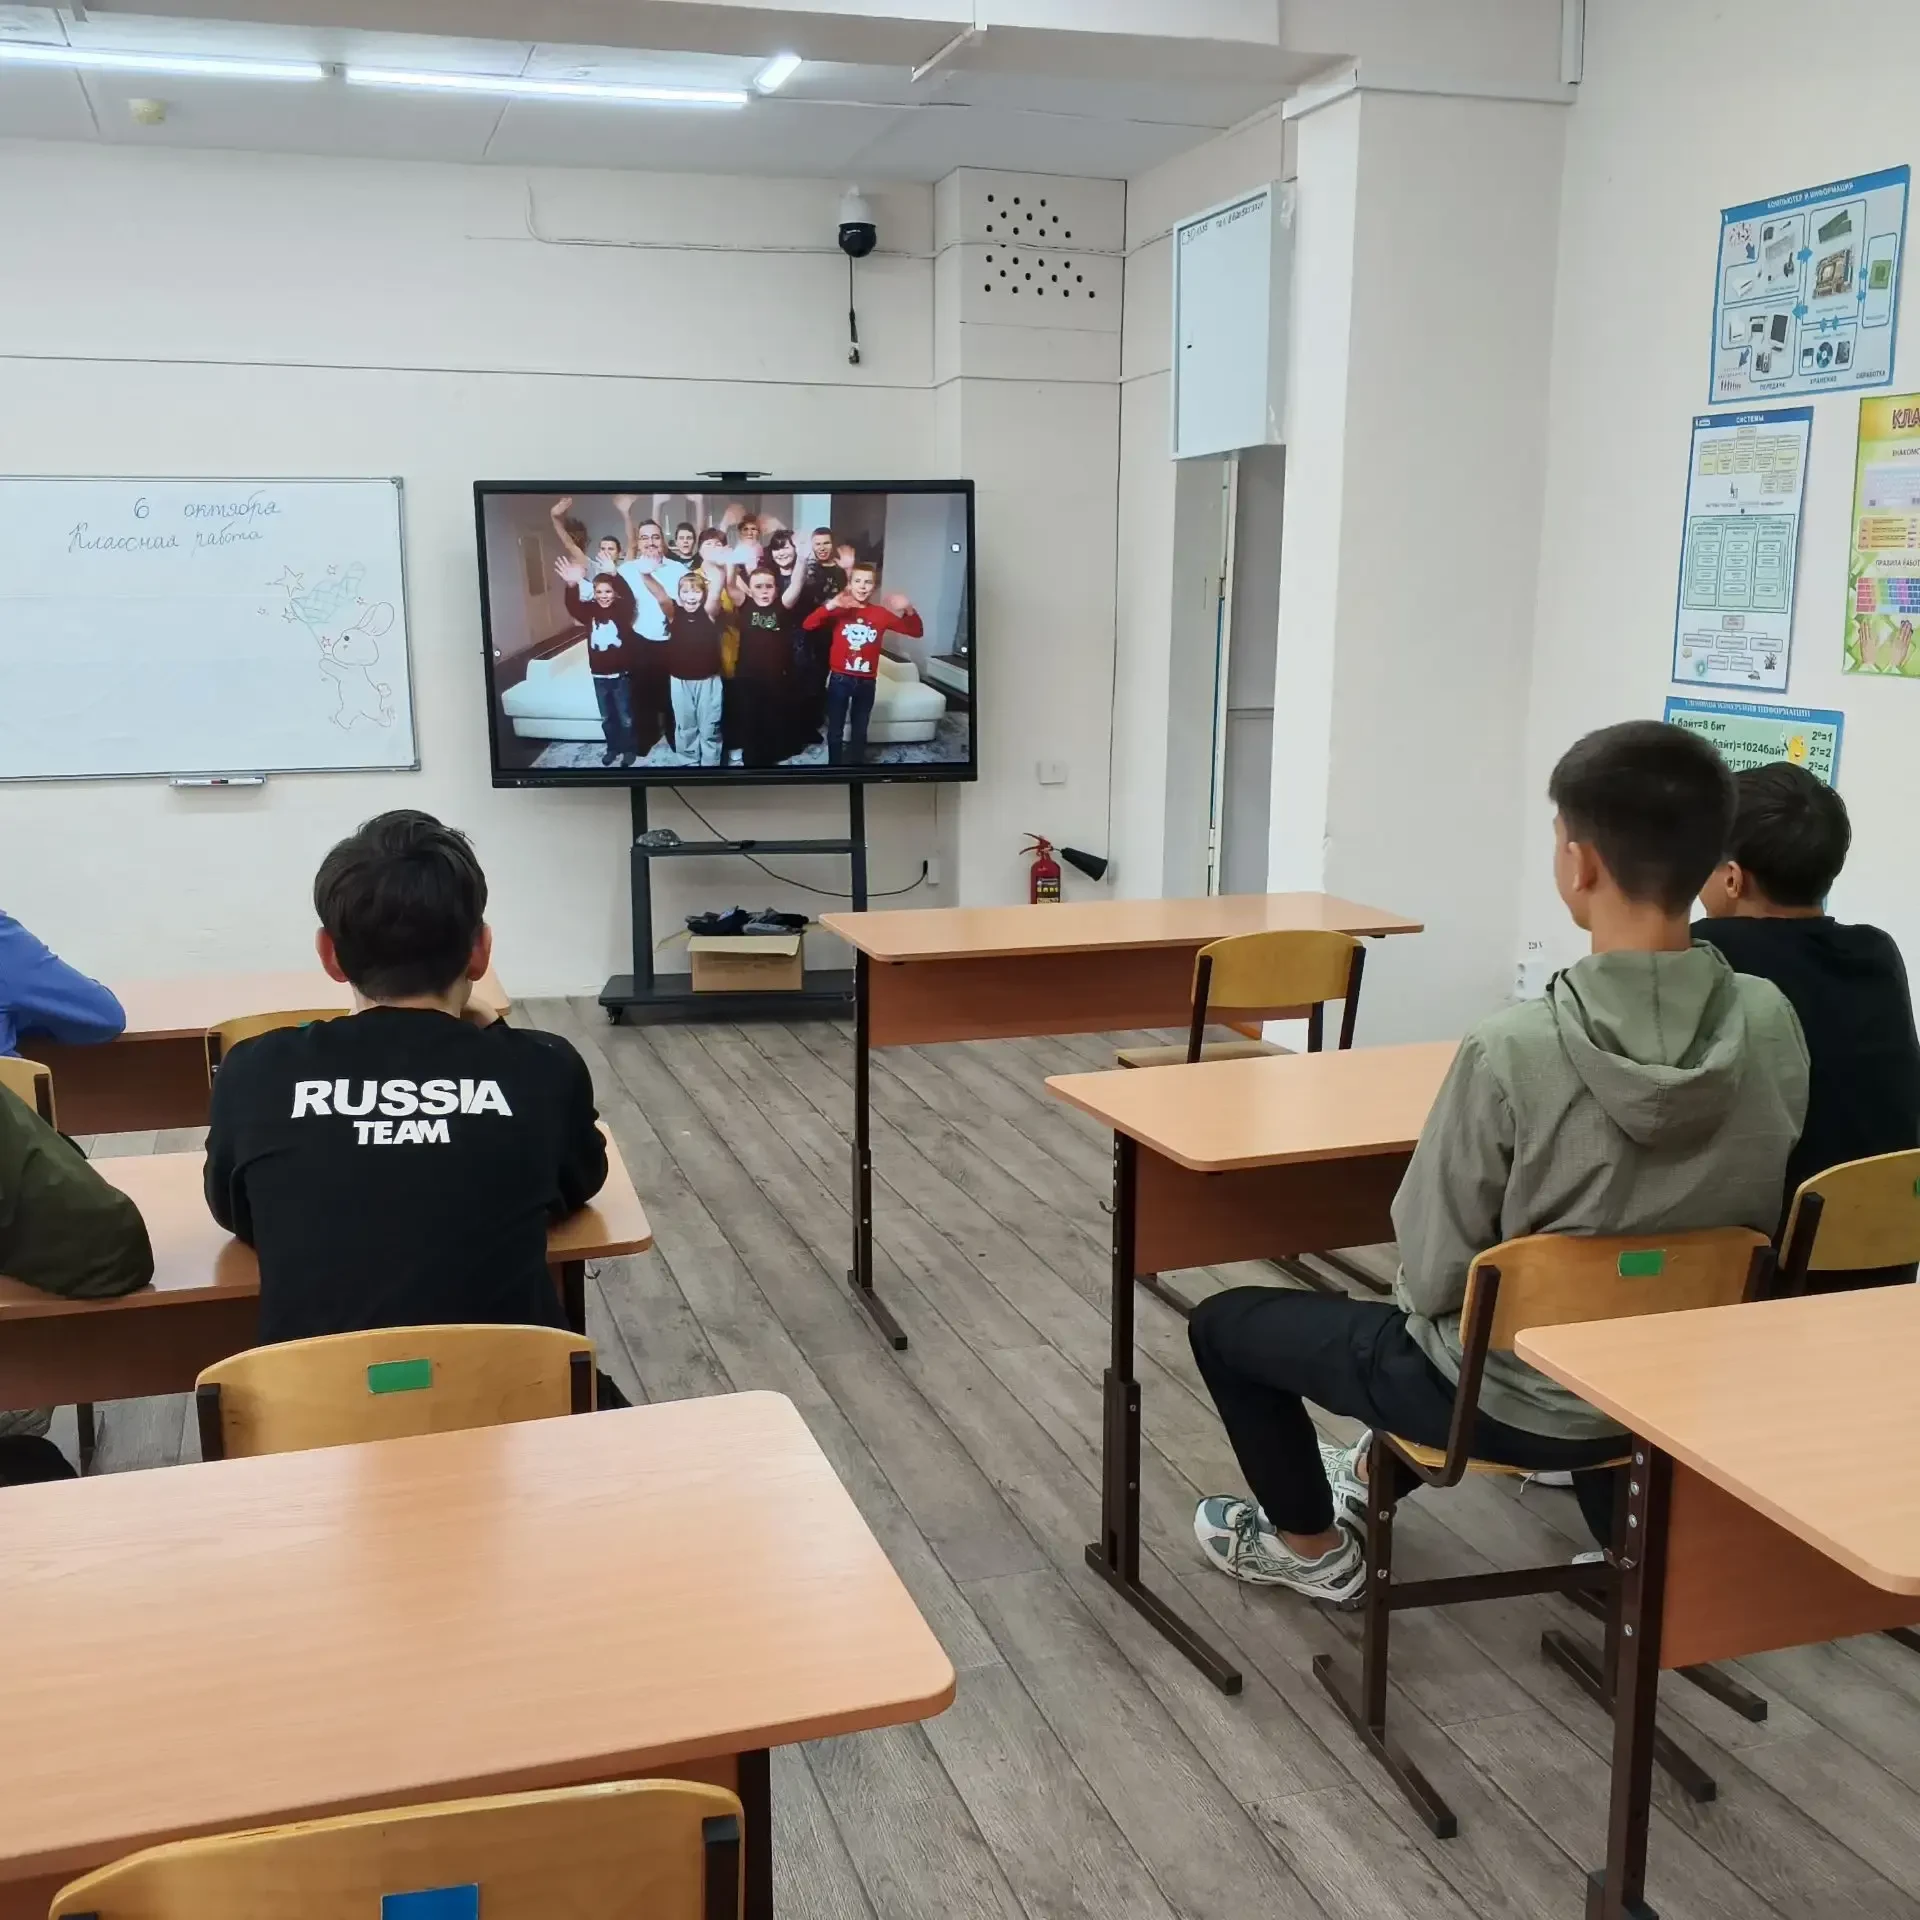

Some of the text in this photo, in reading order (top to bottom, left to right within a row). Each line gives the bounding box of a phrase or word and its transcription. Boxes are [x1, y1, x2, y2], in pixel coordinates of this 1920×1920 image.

[1767, 194, 1804, 209] КОМПЬЮТЕР
[1736, 414, 1765, 425] СИСТЕМЫ
[133, 489, 284, 524] 6 октября
[68, 521, 264, 558] Классная работа
[1710, 721, 1726, 731] бит
[291, 1078, 513, 1118] RUSSIA
[353, 1119, 451, 1145] TEAM
